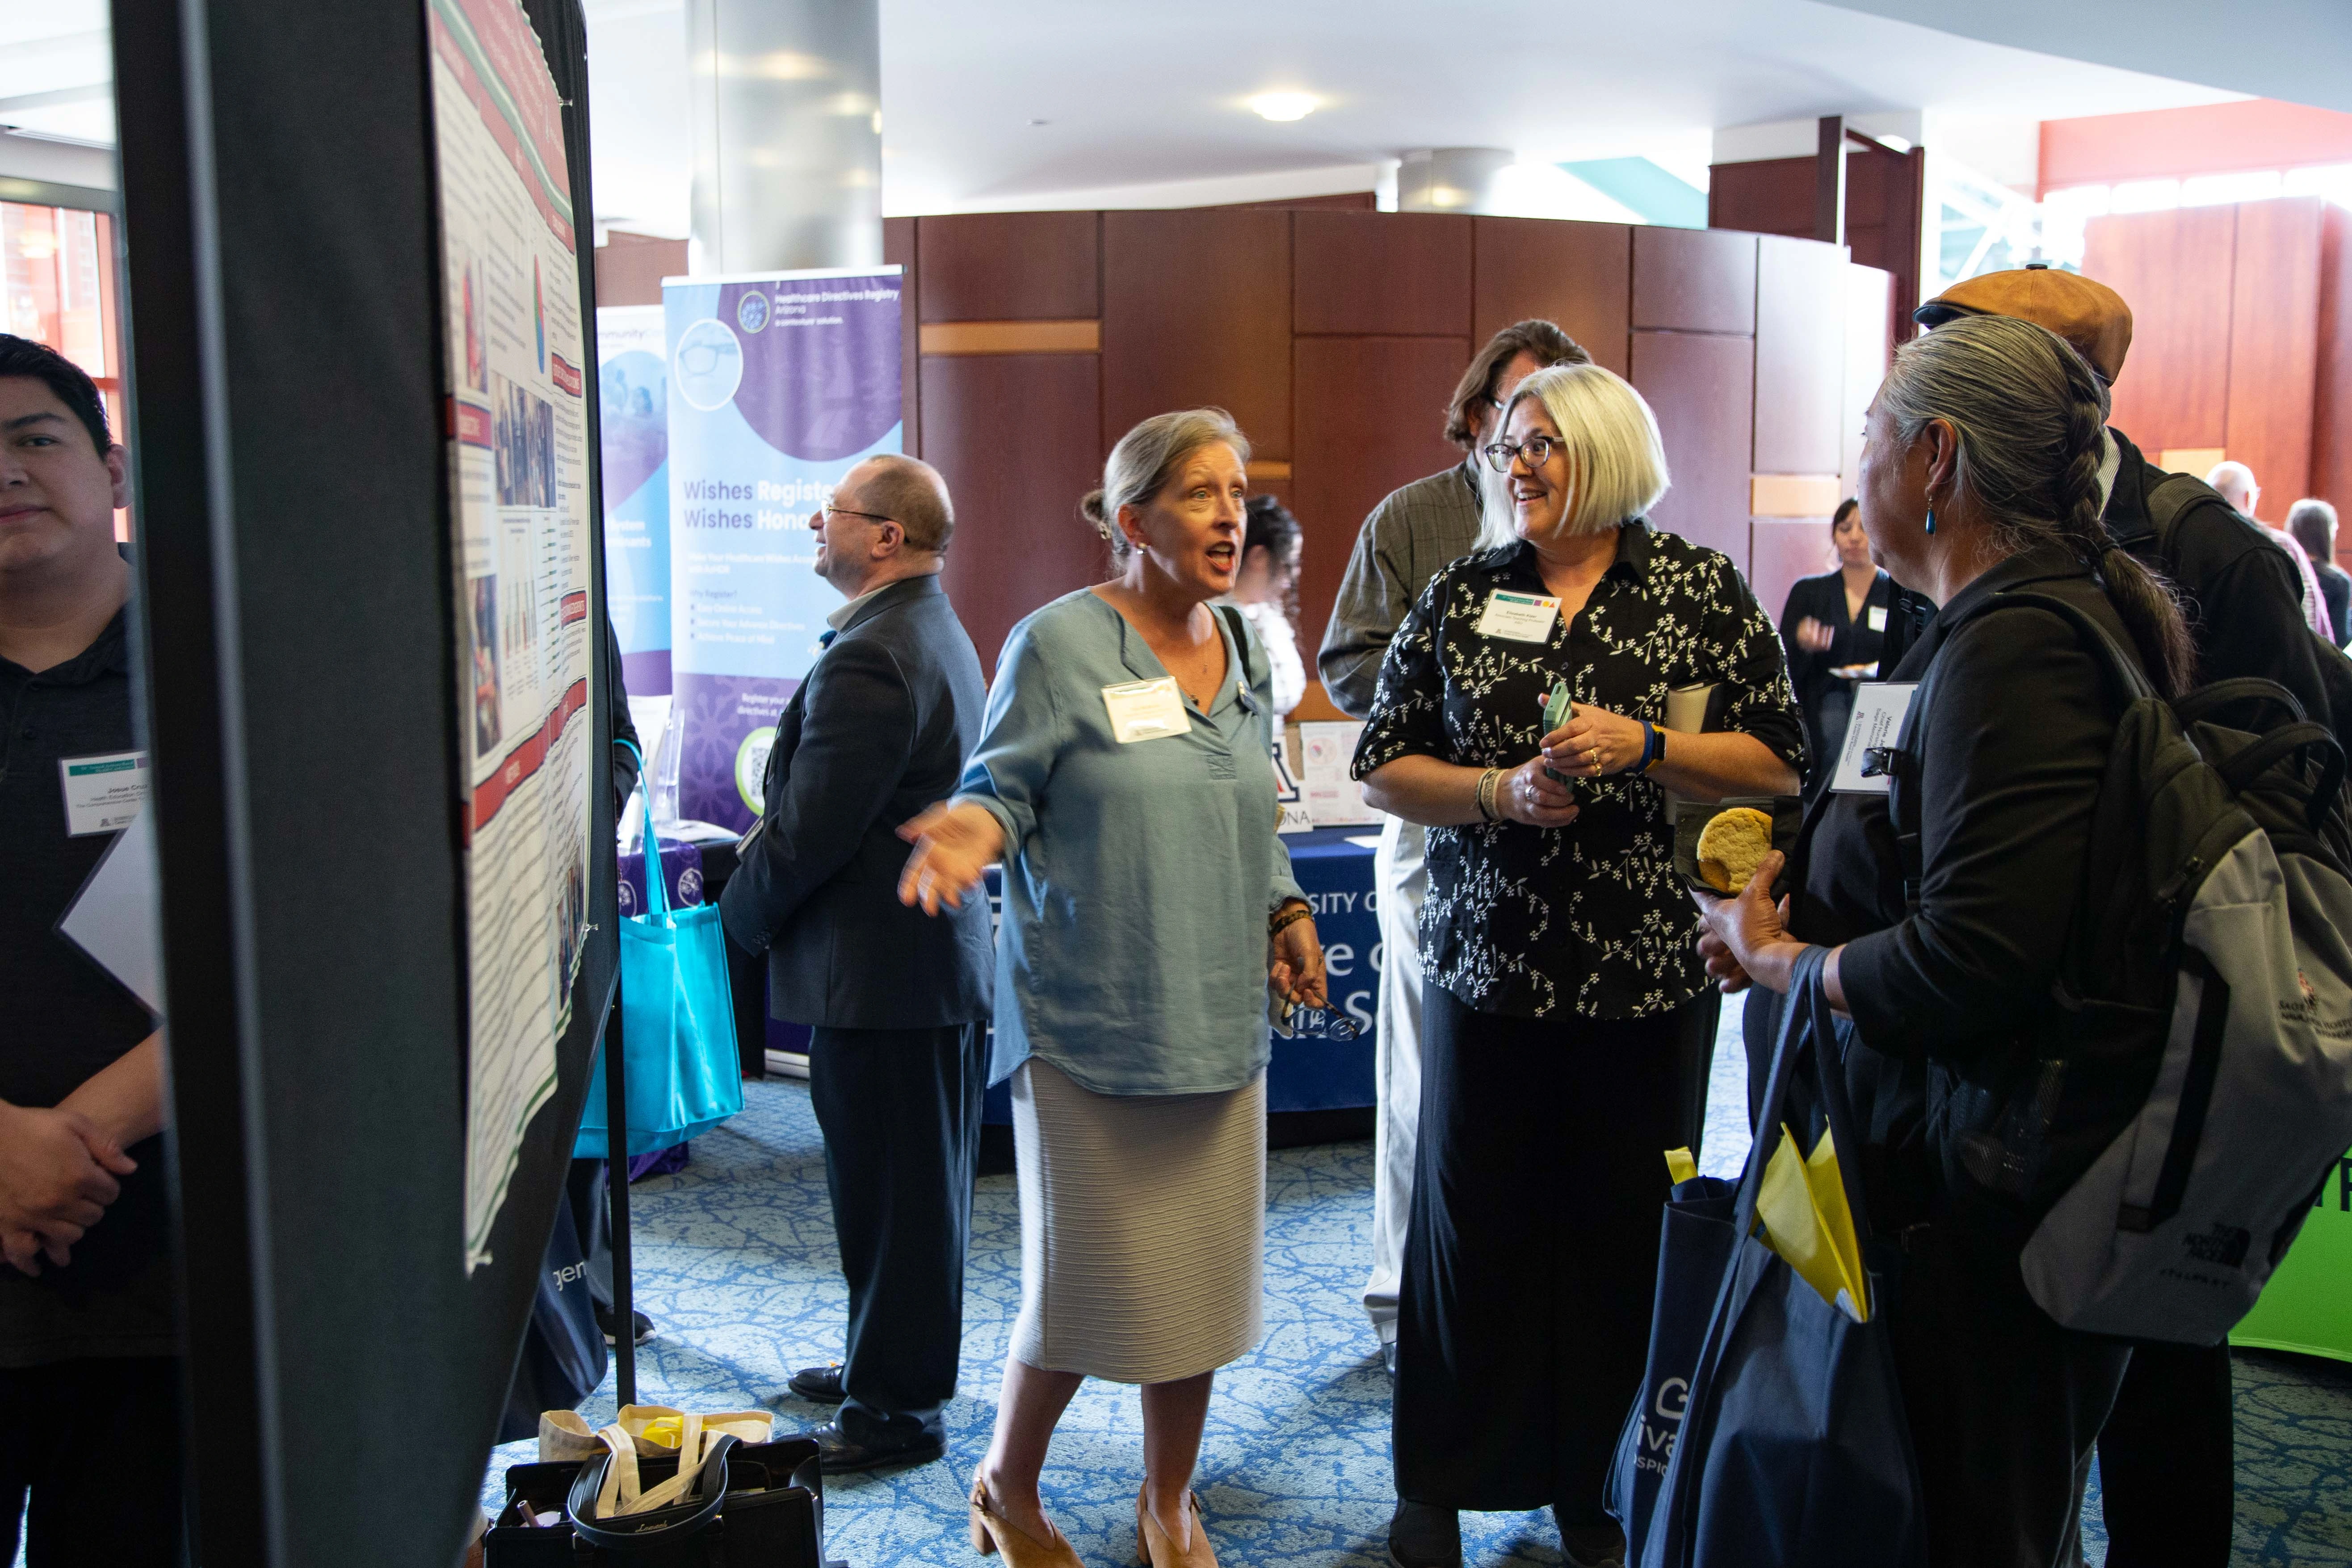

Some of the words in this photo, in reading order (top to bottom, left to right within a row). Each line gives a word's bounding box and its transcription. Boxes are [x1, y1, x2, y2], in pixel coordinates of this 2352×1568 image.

[821, 291, 864, 303] Directives
[864, 288, 900, 303] Registry
[775, 305, 806, 315] Arizona
[684, 479, 753, 500] Wishes
[684, 509, 753, 530] Wishes
[1882, 716, 1893, 737] Valerie
